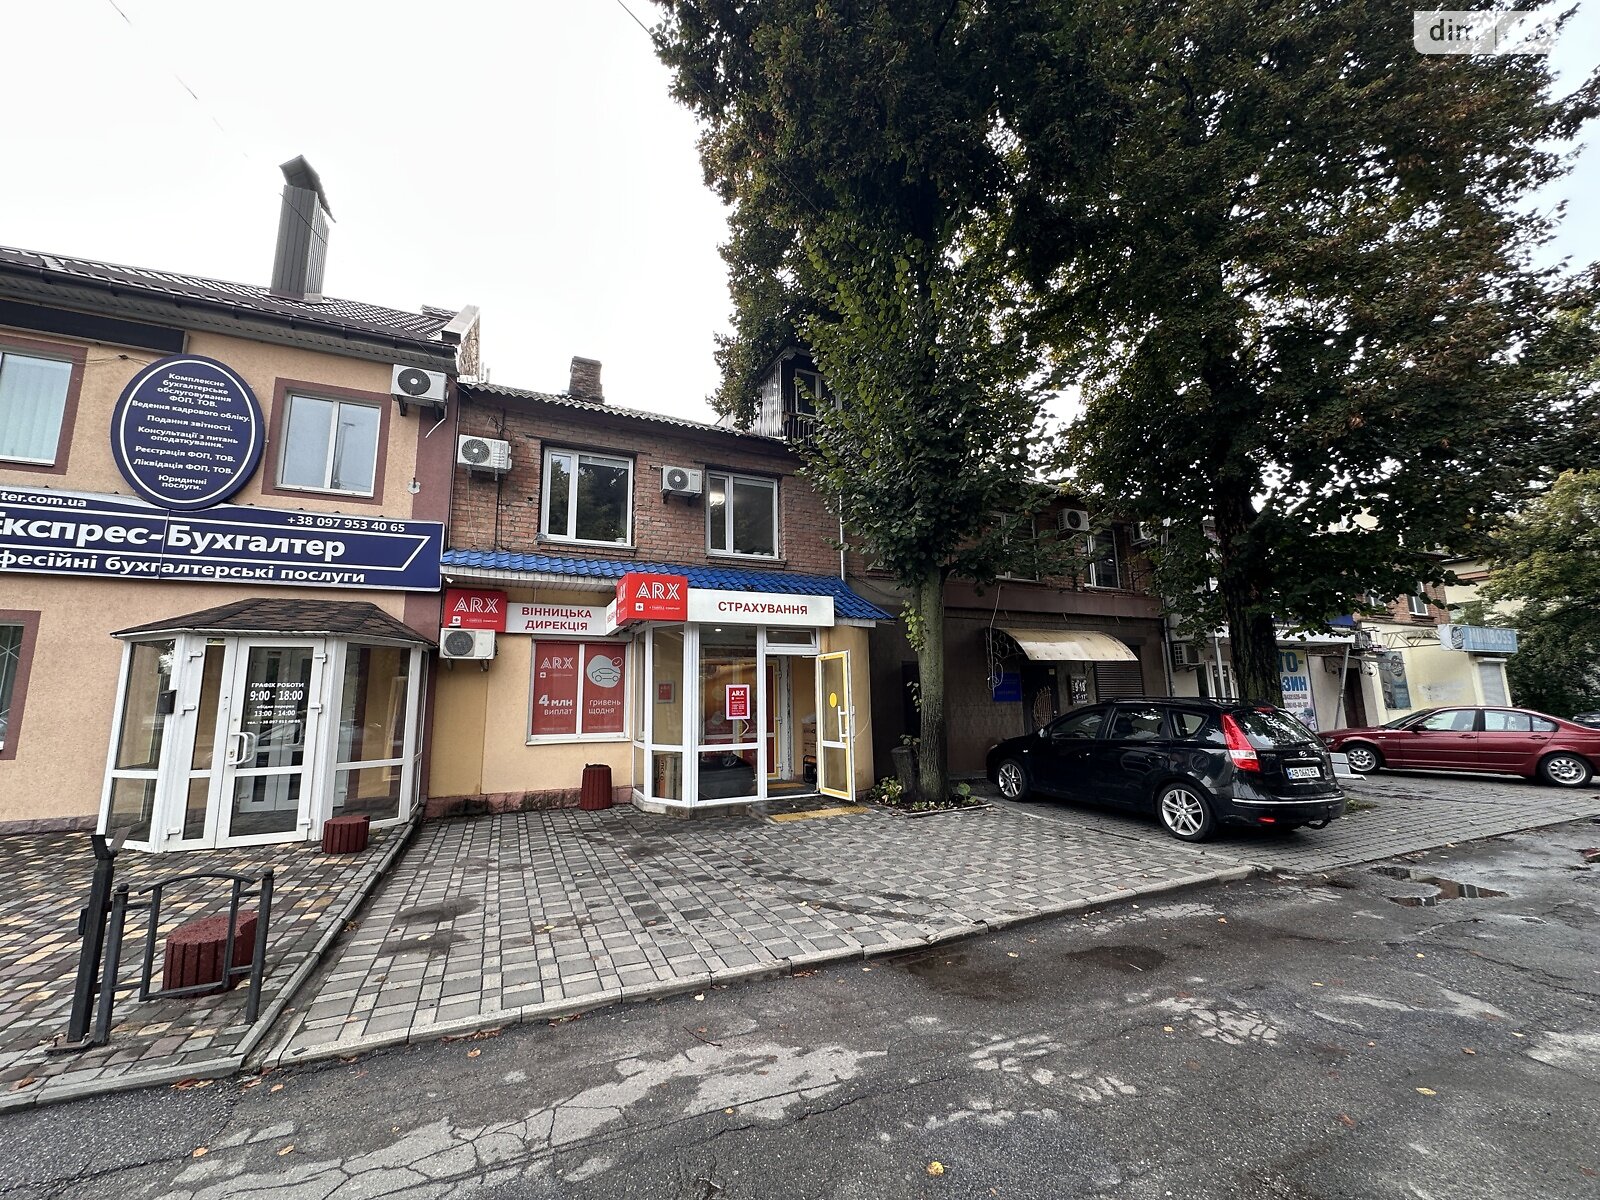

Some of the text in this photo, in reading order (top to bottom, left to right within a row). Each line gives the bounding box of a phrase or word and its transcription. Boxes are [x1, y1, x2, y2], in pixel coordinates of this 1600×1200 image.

[168, 373, 225, 387] Комплексне
[157, 386, 232, 402] обслуговування
[163, 380, 229, 395] бухгалтерське
[169, 396, 218, 408] ФОП, ТОВ.
[132, 400, 251, 422] Ведення кадрового обліку.
[147, 415, 233, 432] Подання звітності.
[138, 426, 197, 438] Консультації
[207, 435, 238, 444] питань
[151, 435, 224, 449] оподаткування.
[136, 446, 236, 462] Реєстрація ФОП, ТОВ.
[134, 459, 233, 474] Ліквідація ФОП, ТОВ.
[158, 475, 208, 485] Юридичні
[162, 482, 202, 491] послуги.
[287, 516, 405, 533] +38 097 953 40 65
[105, 557, 274, 579] бухгалтерські
[280, 569, 365, 584] послуги
[636, 582, 680, 600] ARX
[453, 596, 499, 614] ARX
[718, 601, 808, 614] СТРАХУВАННЯ
[522, 607, 592, 619] ВІННИЦЬКА
[525, 620, 588, 632] ДИРЕКЦІЯ
[540, 657, 574, 670] ARX
[1281, 676, 1307, 691] ЗИН
[250, 691, 270, 701] 9:00
[278, 691, 303, 700] 18:00
[539, 695, 549, 707] 4
[589, 699, 621, 707] гривень
[544, 708, 573, 716] виплат
[588, 707, 615, 715] щодня
